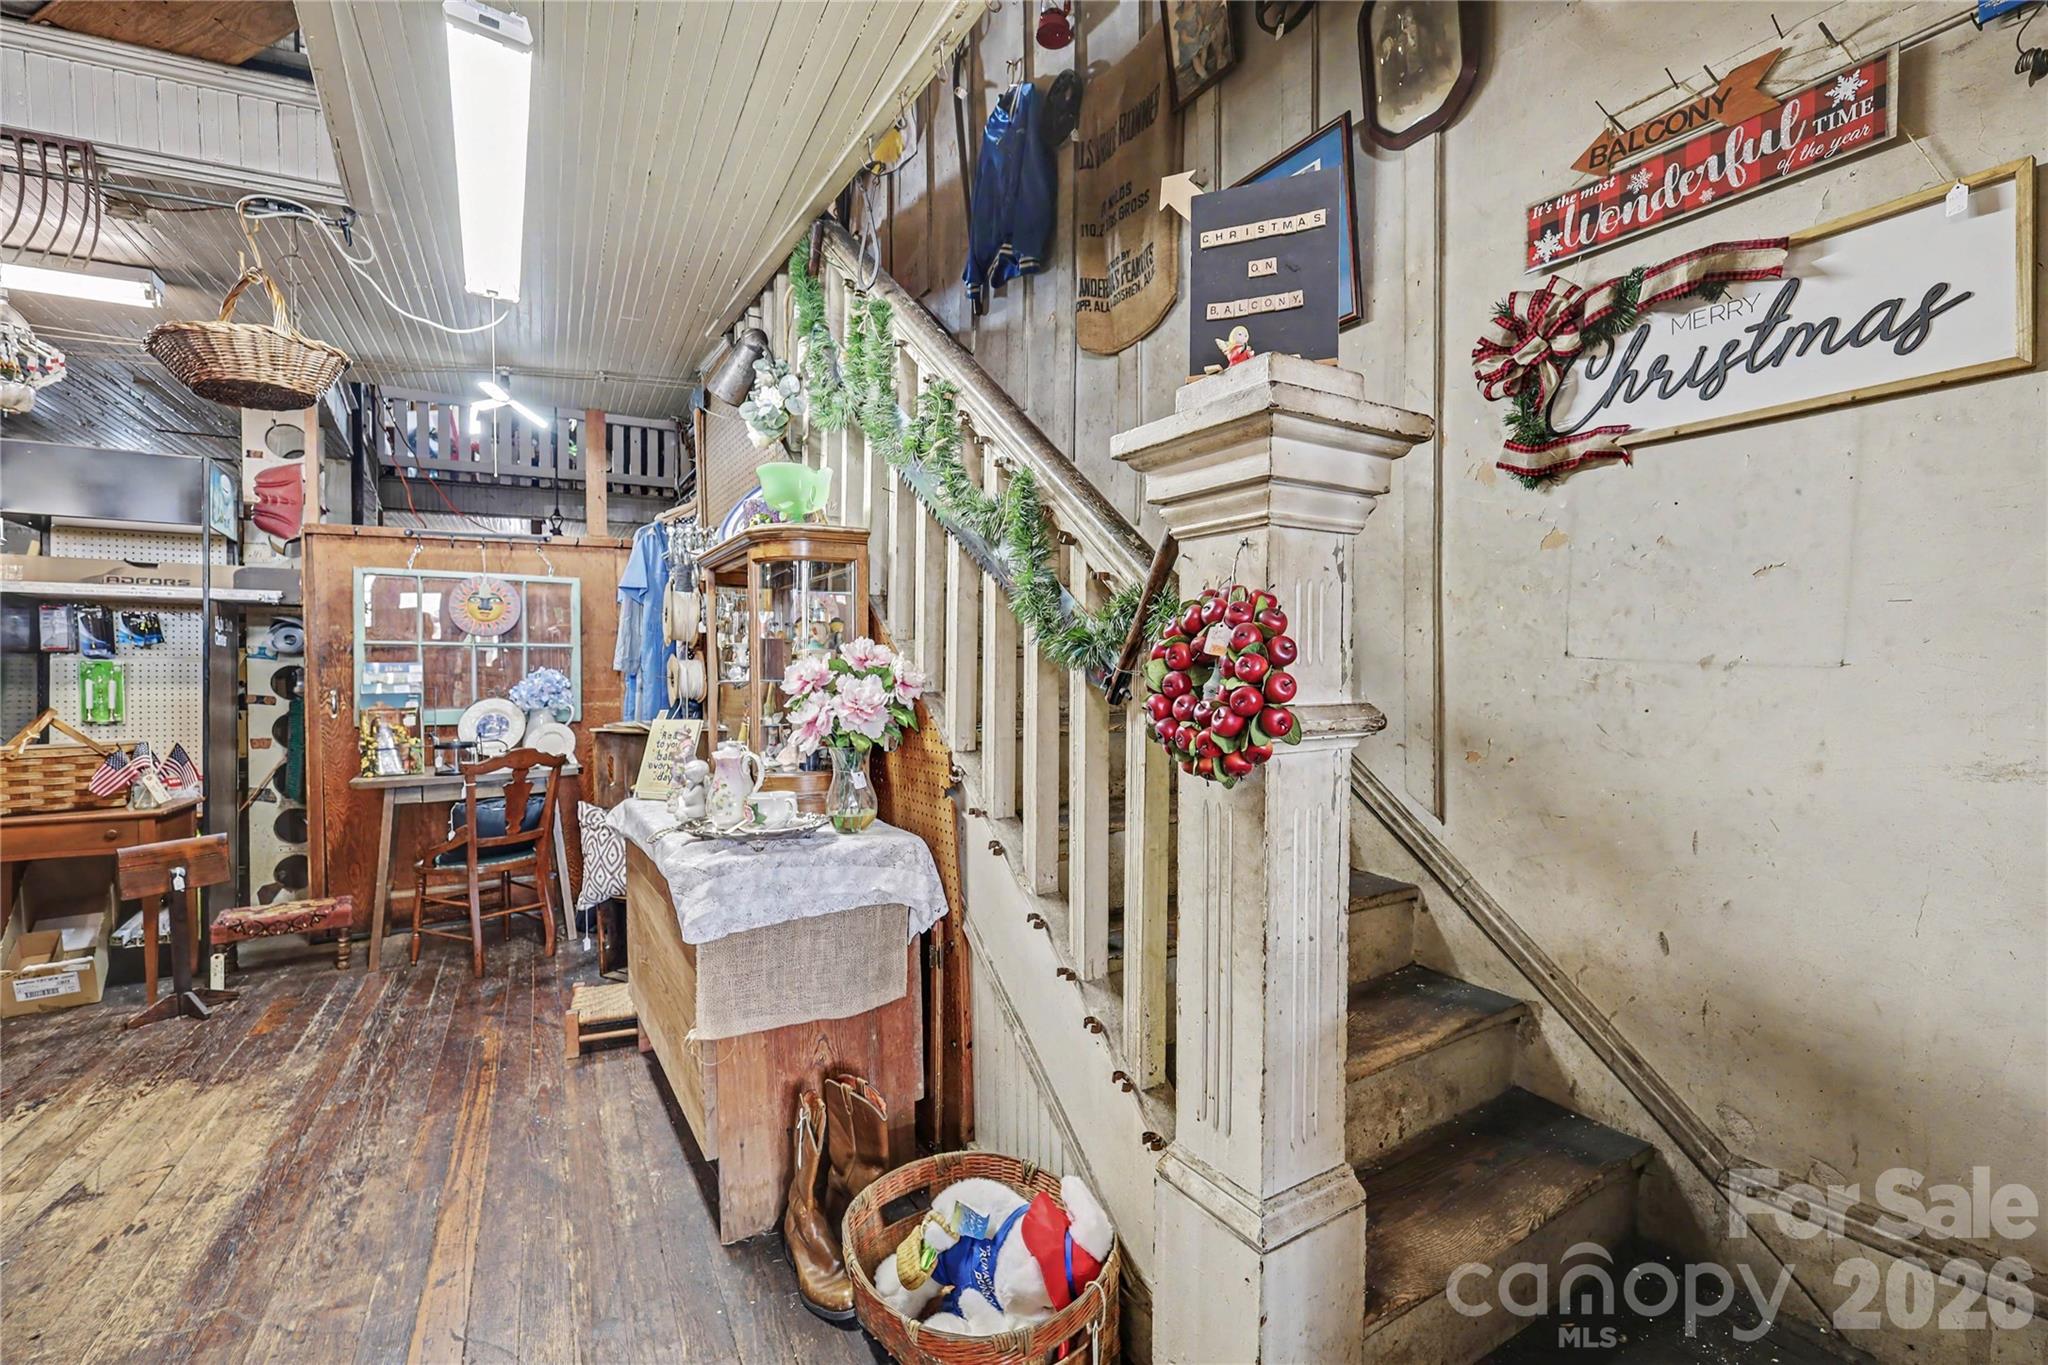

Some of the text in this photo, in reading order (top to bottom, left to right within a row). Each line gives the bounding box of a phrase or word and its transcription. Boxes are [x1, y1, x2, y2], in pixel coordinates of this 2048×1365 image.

[1588, 87, 1732, 170] BALCONY
[1812, 96, 1874, 137] TIME
[1776, 125, 1872, 177] of the year
[1564, 98, 1807, 248] Wonderful
[1119, 189, 1150, 221] GROSS
[1531, 176, 1616, 220] It's the most
[1202, 212, 1322, 245] CHRISTMAS
[1250, 260, 1275, 274] ON
[1209, 294, 1302, 316] BALCONY
[1671, 293, 1760, 335] MERRY
[1545, 278, 1975, 436] Christmas
[656, 740, 665, 748] to
[656, 771, 673, 785] day
